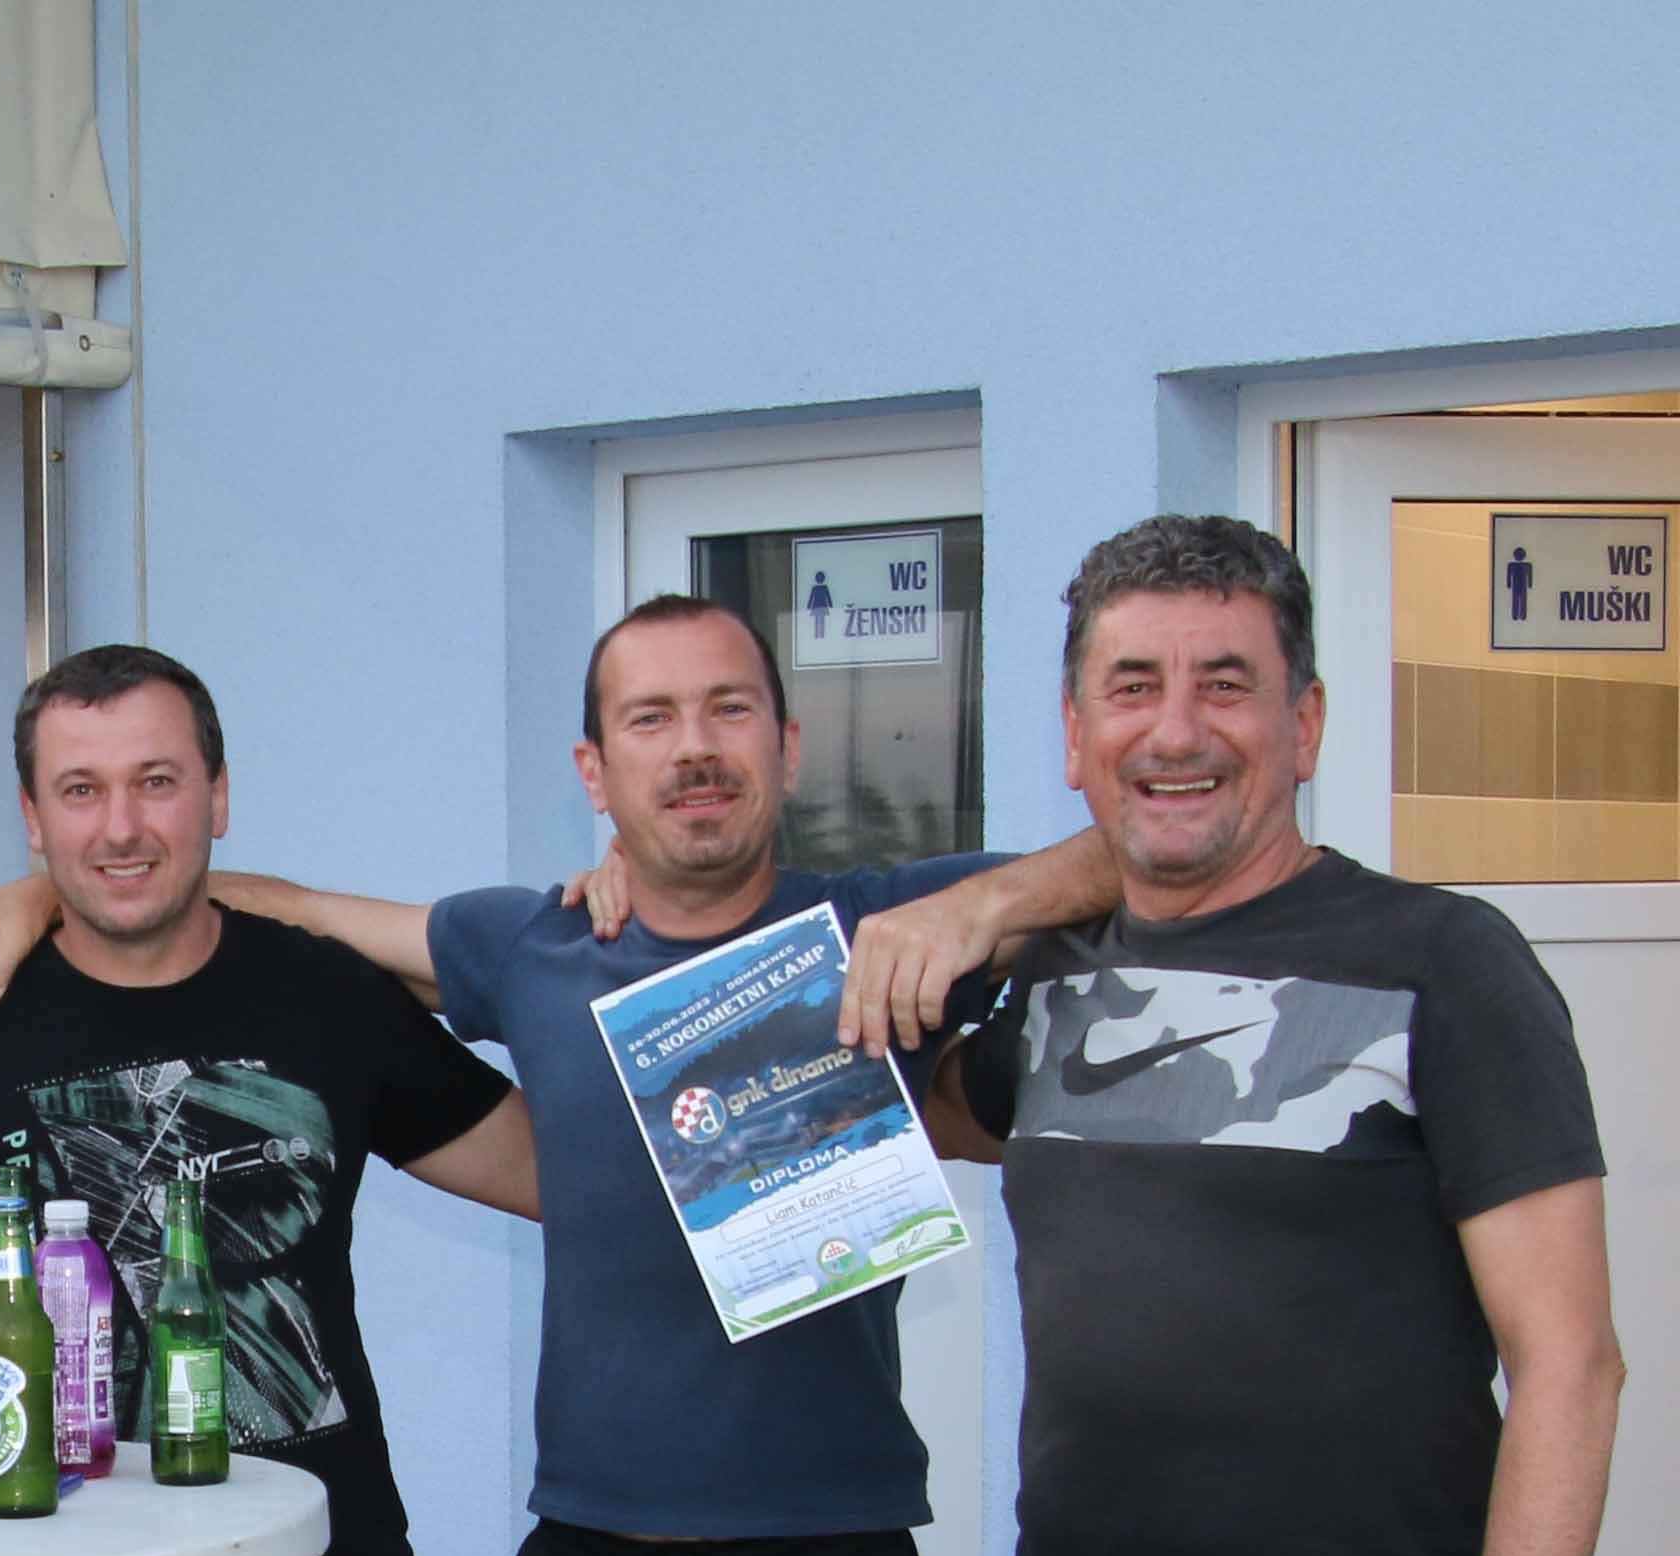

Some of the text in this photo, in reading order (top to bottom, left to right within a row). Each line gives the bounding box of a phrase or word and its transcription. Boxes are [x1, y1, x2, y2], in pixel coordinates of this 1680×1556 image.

[889, 560, 928, 591] WC
[1607, 545, 1653, 576] WC
[844, 603, 927, 637] ŽENSKI
[1559, 585, 1651, 622] MUŠKI
[635, 944, 826, 1069] 6. NOGOMETNI KAMP
[727, 1048, 855, 1116] gnk dinamo
[749, 1144, 849, 1193] DIPLOMA
